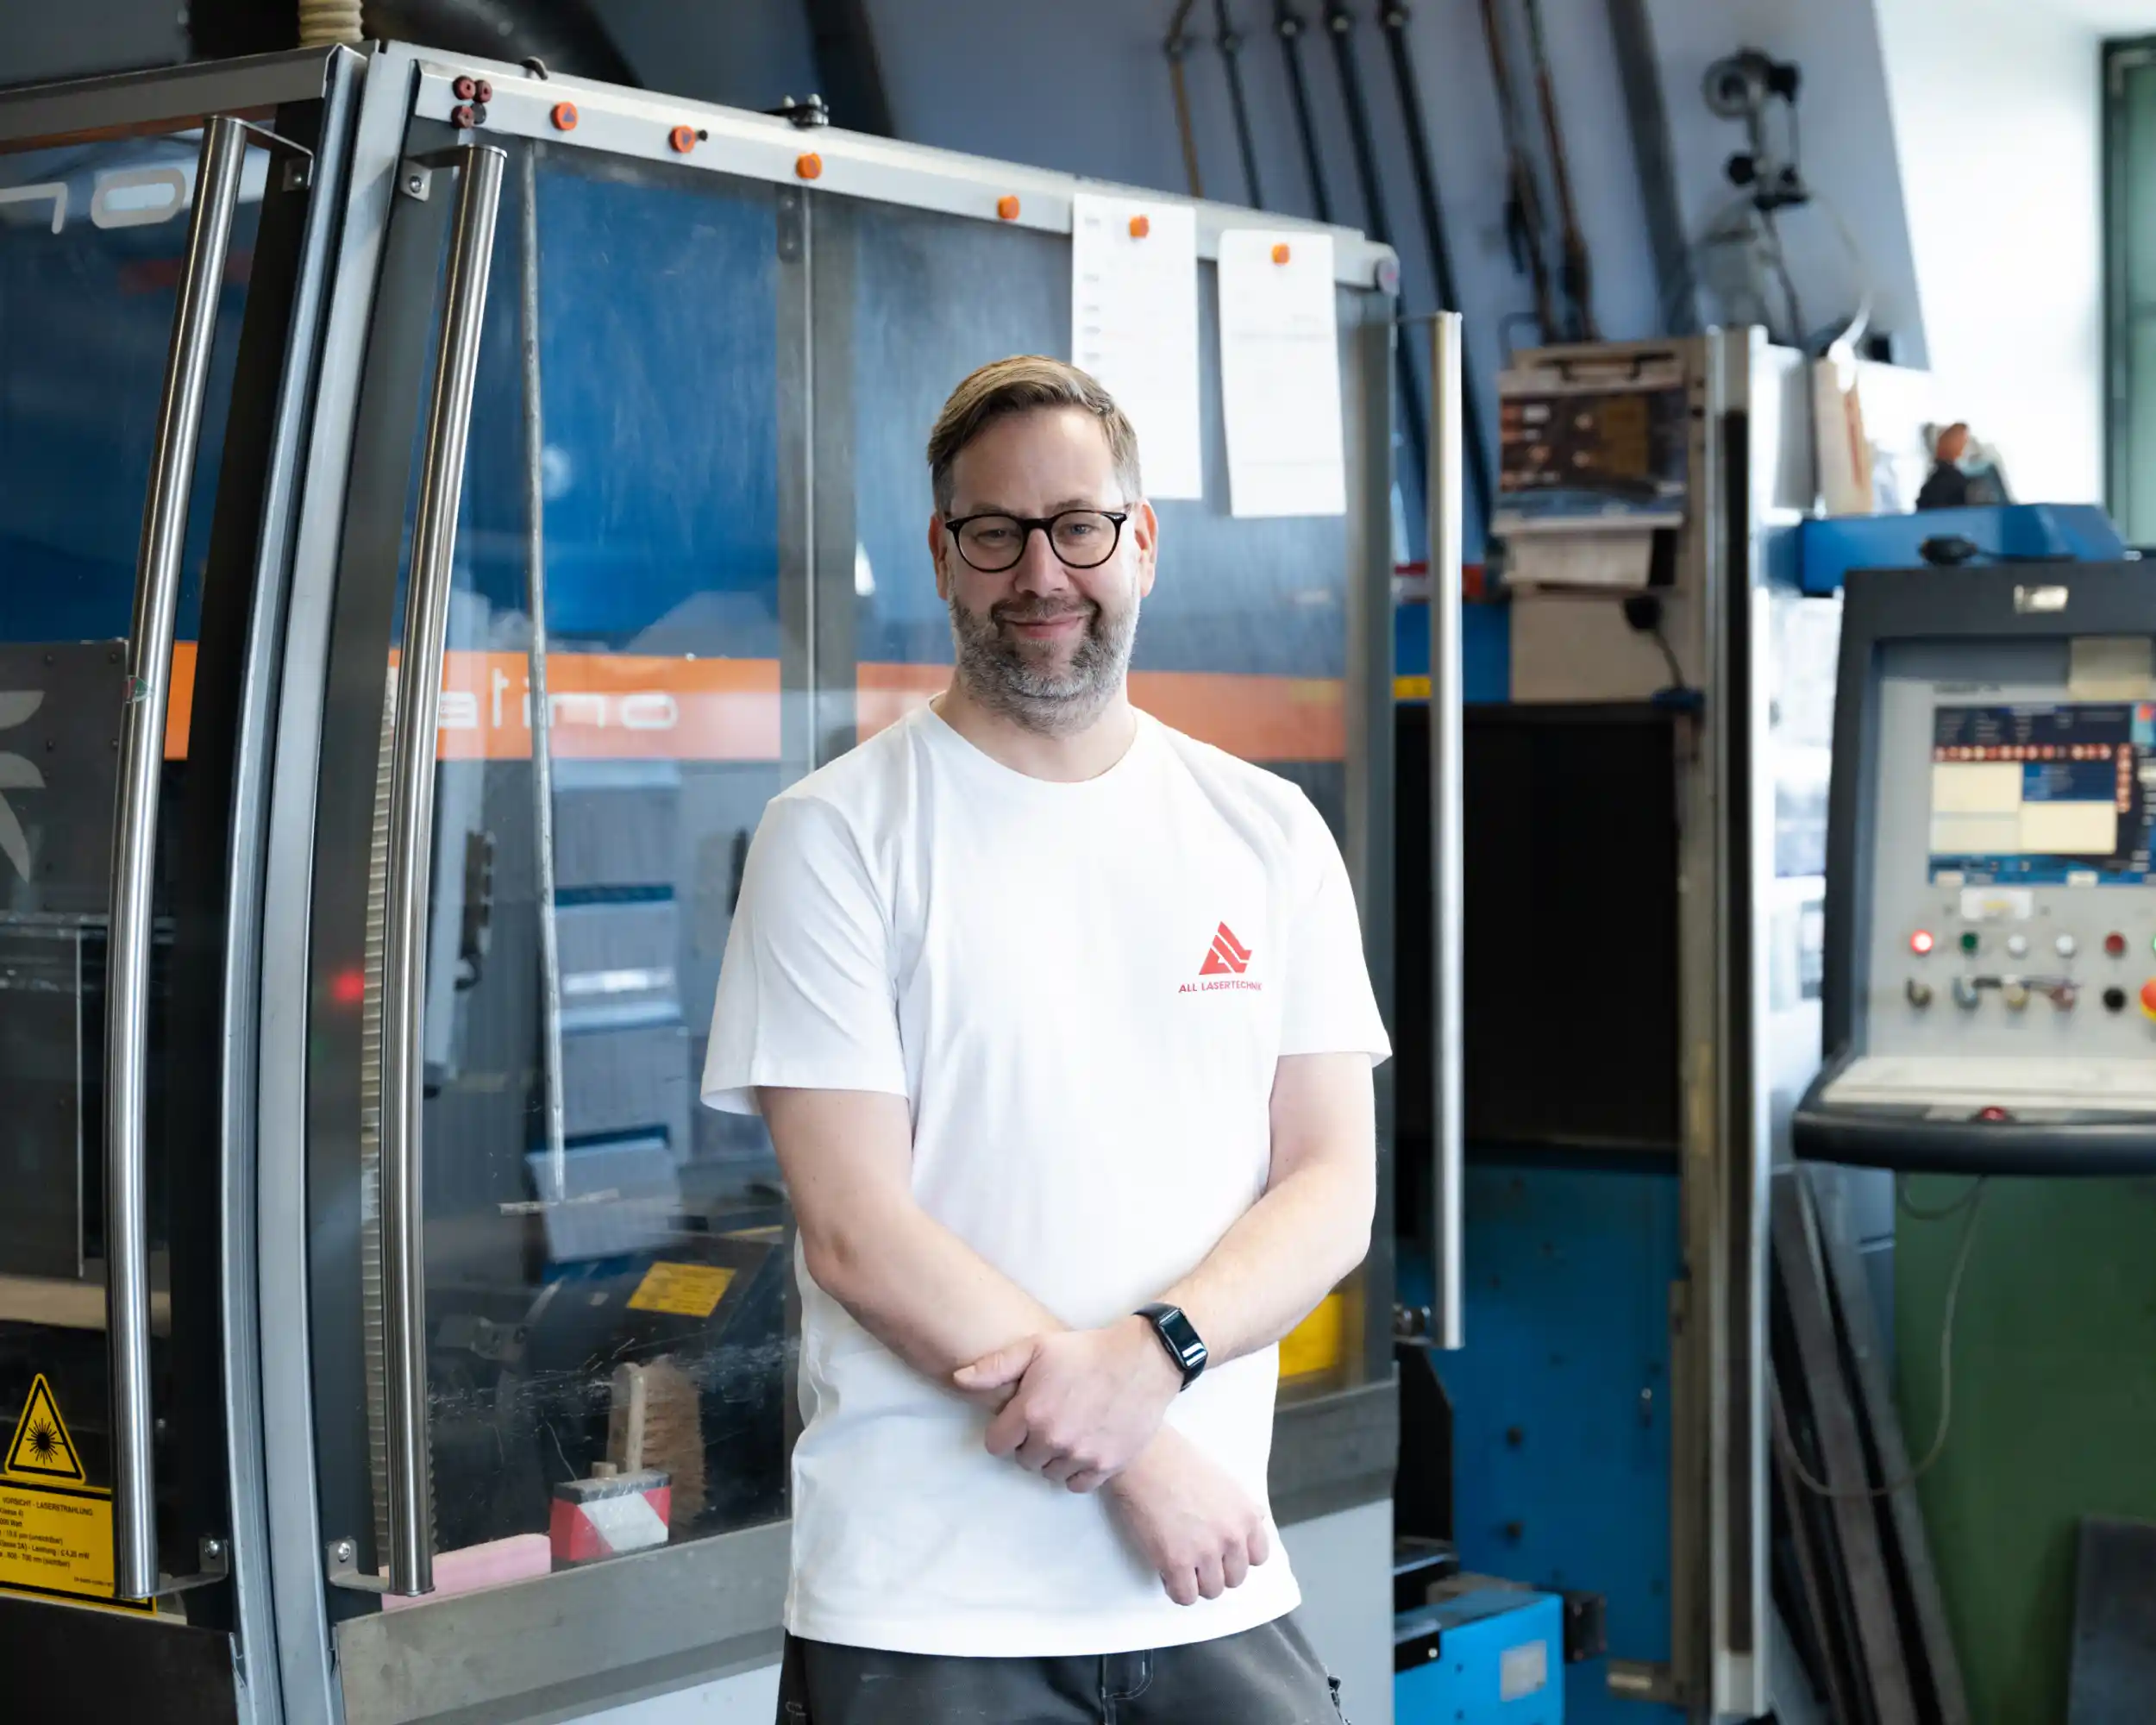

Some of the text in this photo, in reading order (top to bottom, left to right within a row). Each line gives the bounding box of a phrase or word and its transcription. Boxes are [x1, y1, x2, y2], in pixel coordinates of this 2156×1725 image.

[1178, 983, 1197, 993] ALL
[3, 1496, 31, 1507] VORSICHT
[36, 1501, 93, 1516] LASERSTRAHLUNG
